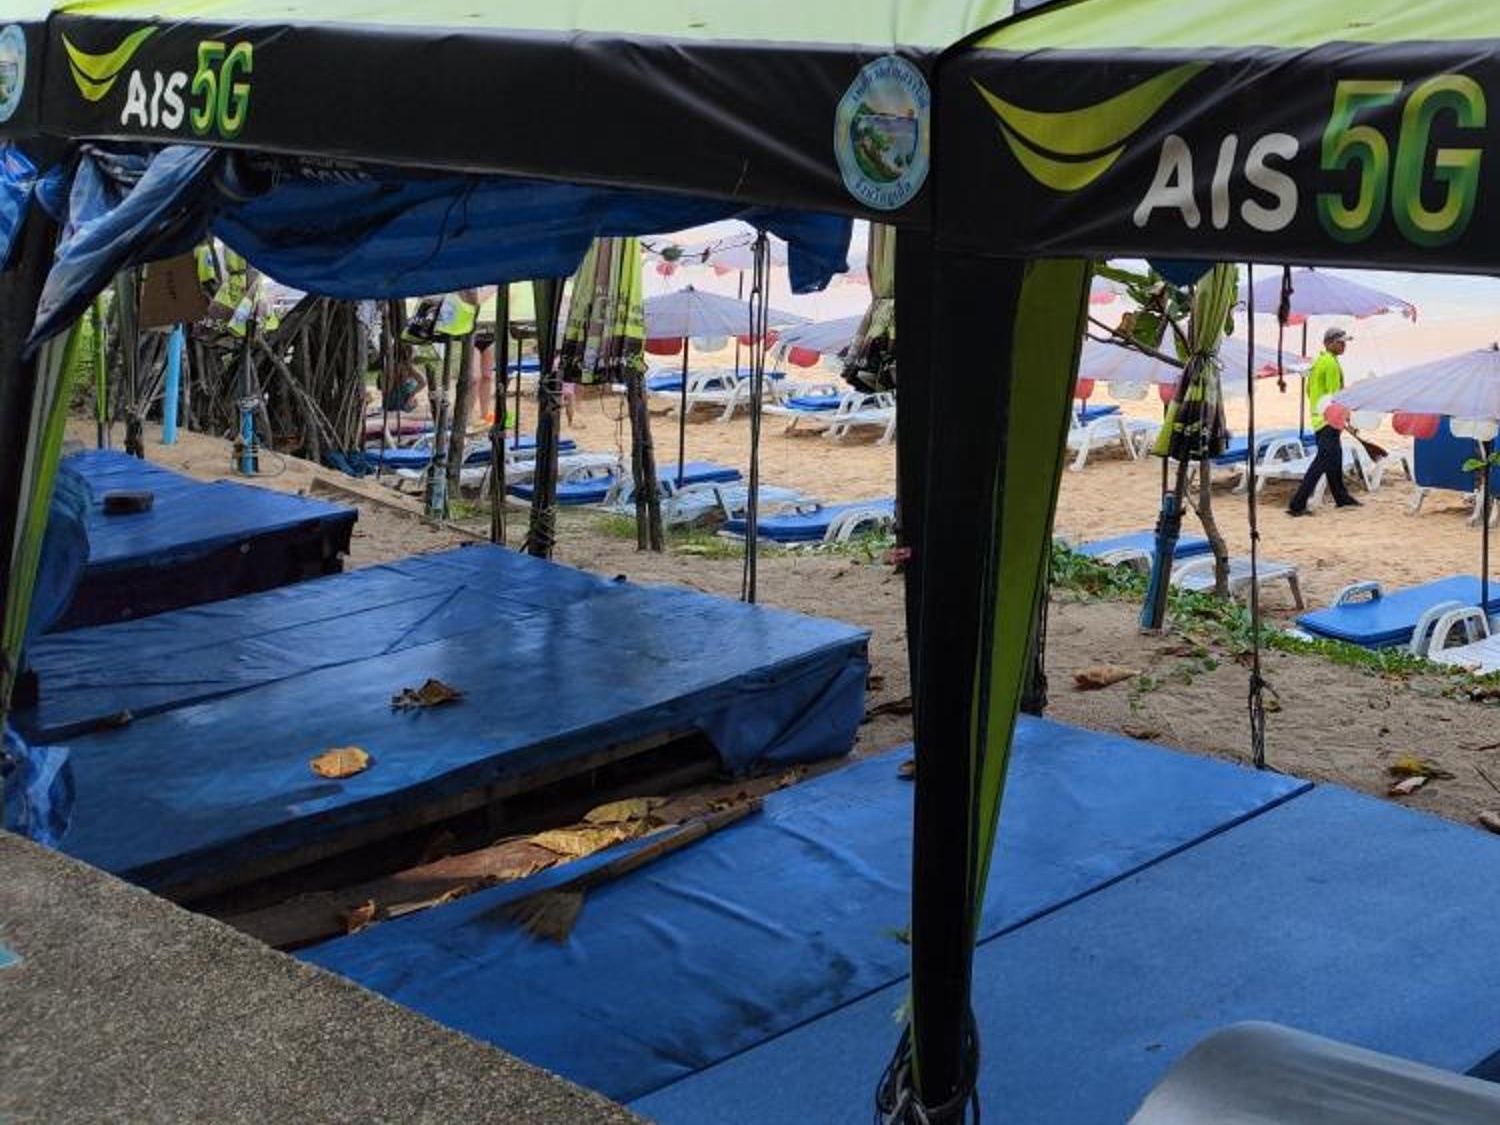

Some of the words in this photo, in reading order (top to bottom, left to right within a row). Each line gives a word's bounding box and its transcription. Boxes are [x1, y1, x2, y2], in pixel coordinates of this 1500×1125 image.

[121, 69, 189, 131] AIS
[190, 40, 254, 139] 5G
[1132, 133, 1300, 232] AIS
[1316, 74, 1488, 248] 5G
